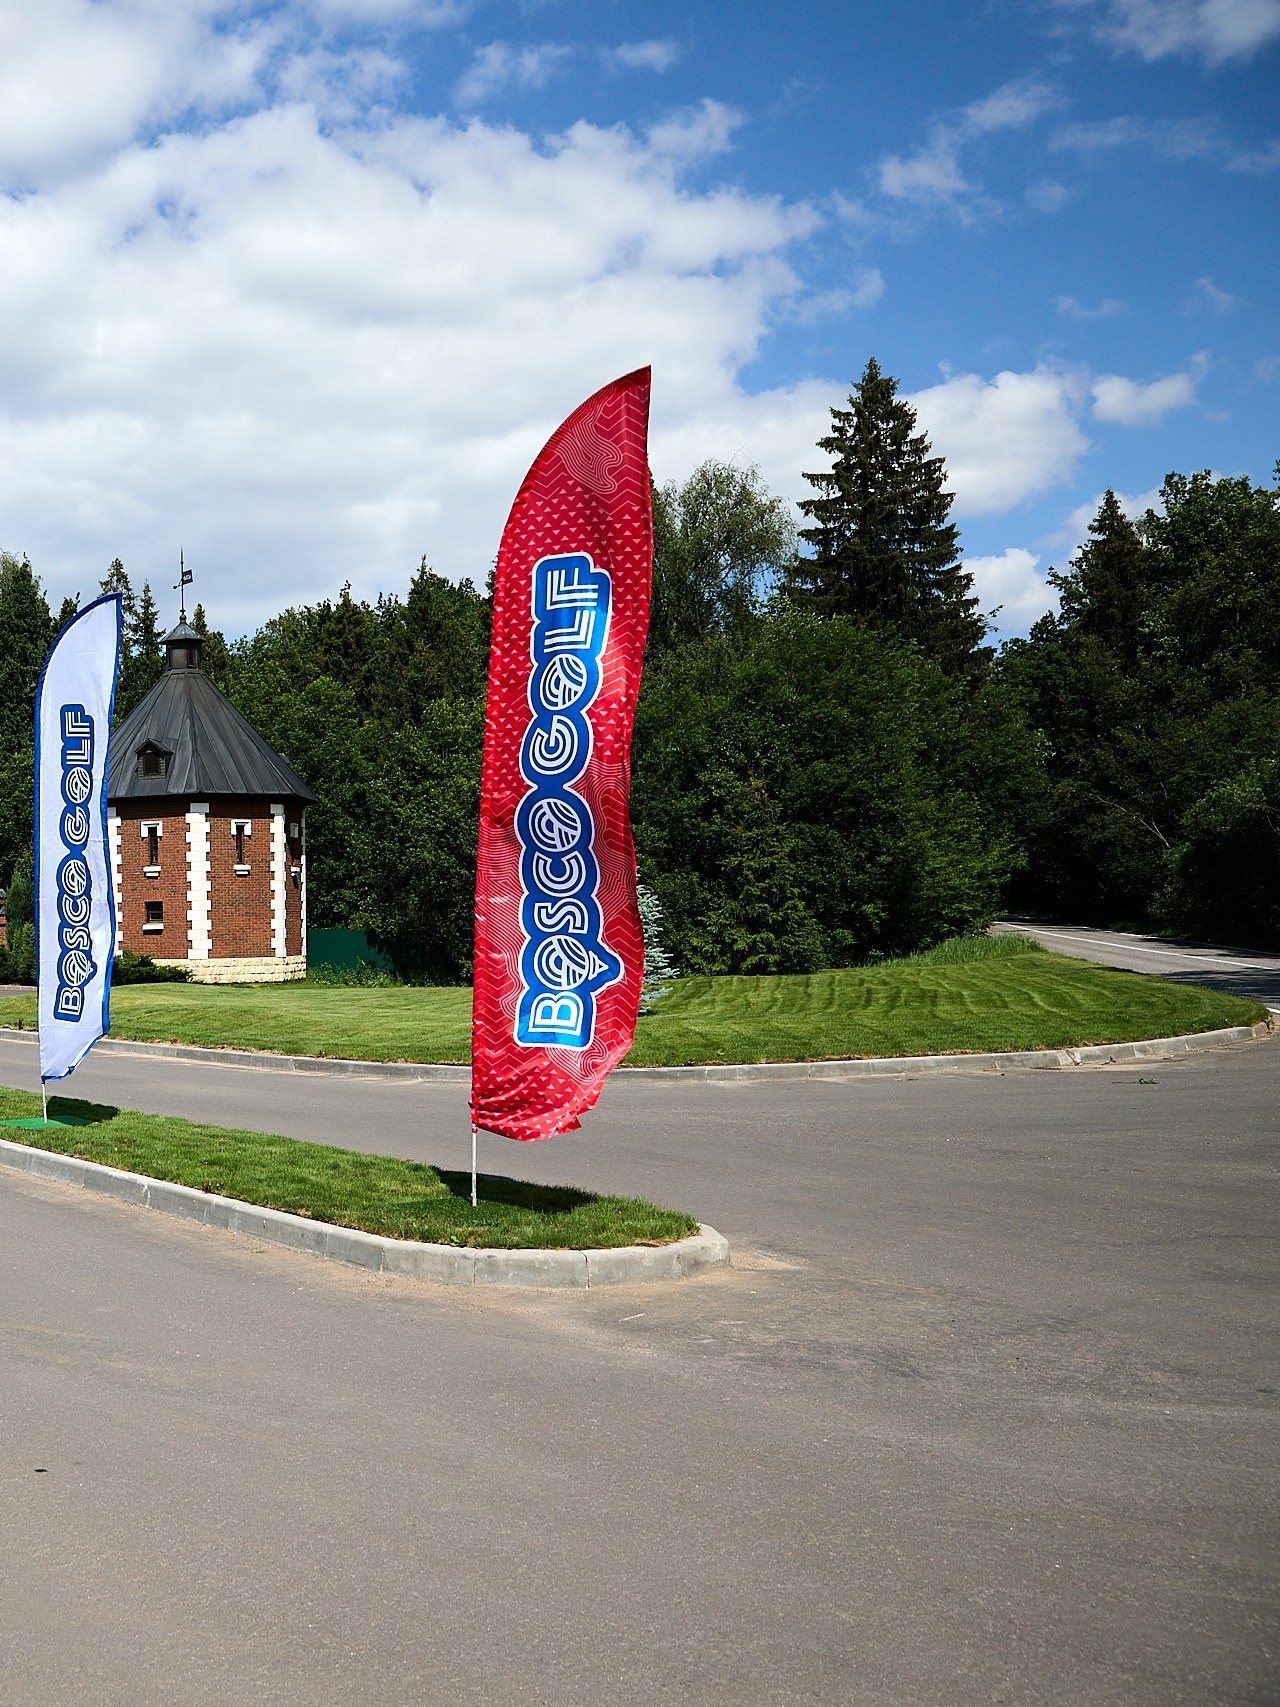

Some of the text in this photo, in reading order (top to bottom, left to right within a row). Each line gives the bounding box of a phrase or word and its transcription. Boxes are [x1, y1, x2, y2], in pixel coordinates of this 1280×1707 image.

[57, 711, 93, 1016] BOSCO GOLF
[528, 566, 600, 1039] BOSCO GOLF
